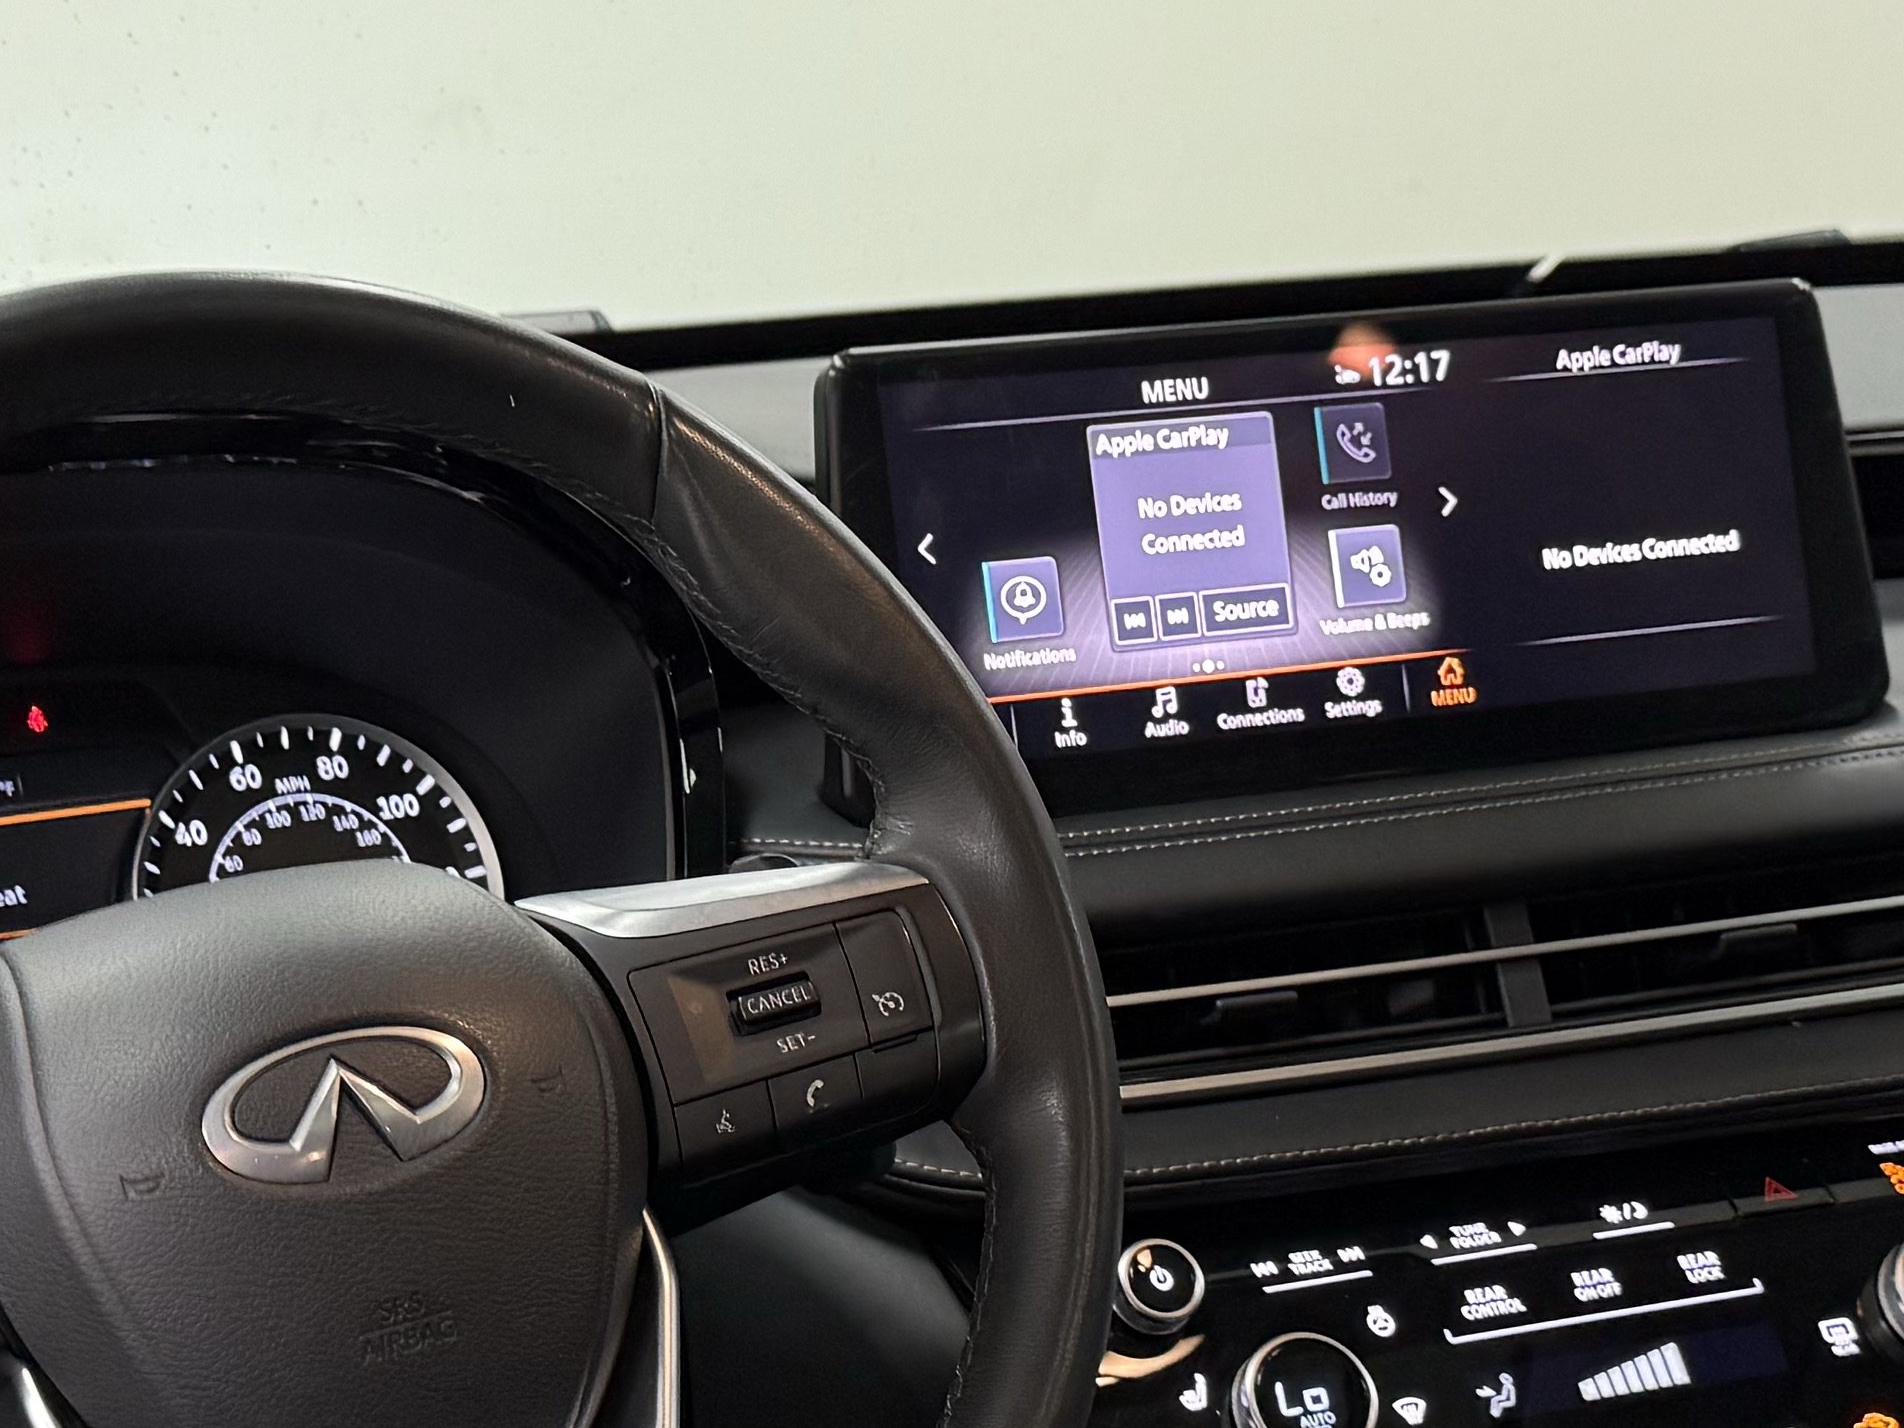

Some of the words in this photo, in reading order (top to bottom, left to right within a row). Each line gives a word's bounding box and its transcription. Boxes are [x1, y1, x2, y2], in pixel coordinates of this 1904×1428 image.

[1369, 350, 1451, 386] 12:17
[1556, 345, 1612, 372] Apple
[1612, 341, 1682, 365] CarPlay
[1141, 377, 1209, 404] MENU
[1096, 431, 1154, 457] Apple
[1156, 425, 1229, 449] CarPlay
[1137, 498, 1167, 519] No
[1170, 492, 1243, 516] Devices
[1321, 493, 1346, 510] Call
[1348, 491, 1398, 508] History
[1141, 525, 1245, 555] Connected
[1542, 547, 1572, 570] No
[1572, 542, 1642, 567] Devices
[1641, 529, 1741, 560] Connected
[1212, 599, 1280, 622] Source
[1320, 617, 1373, 635] Volume
[1387, 612, 1431, 630] Beeps
[984, 647, 1076, 670] Notifications
[1054, 729, 1087, 748] Info
[1145, 719, 1190, 738] Audio
[1216, 708, 1305, 730] Connections
[1324, 699, 1383, 719] Settings
[1430, 686, 1478, 707] MENU
[229, 764, 262, 792] 60
[315, 754, 349, 780] 80
[274, 775, 311, 795] MPH
[376, 793, 420, 821] 100
[265, 810, 292, 829] 100
[174, 819, 209, 847] 40
[748, 952, 788, 975] RES+
[747, 988, 809, 1014] CANCEL
[776, 1032, 815, 1053] SET-
[1676, 1251, 1722, 1271] REAR
[1570, 1268, 1614, 1286] REAR
[1685, 1266, 1726, 1284] LOCK
[1463, 1284, 1509, 1304] REAR
[1460, 1297, 1527, 1321] CONTROL
[1300, 1411, 1337, 1428] AUTO
